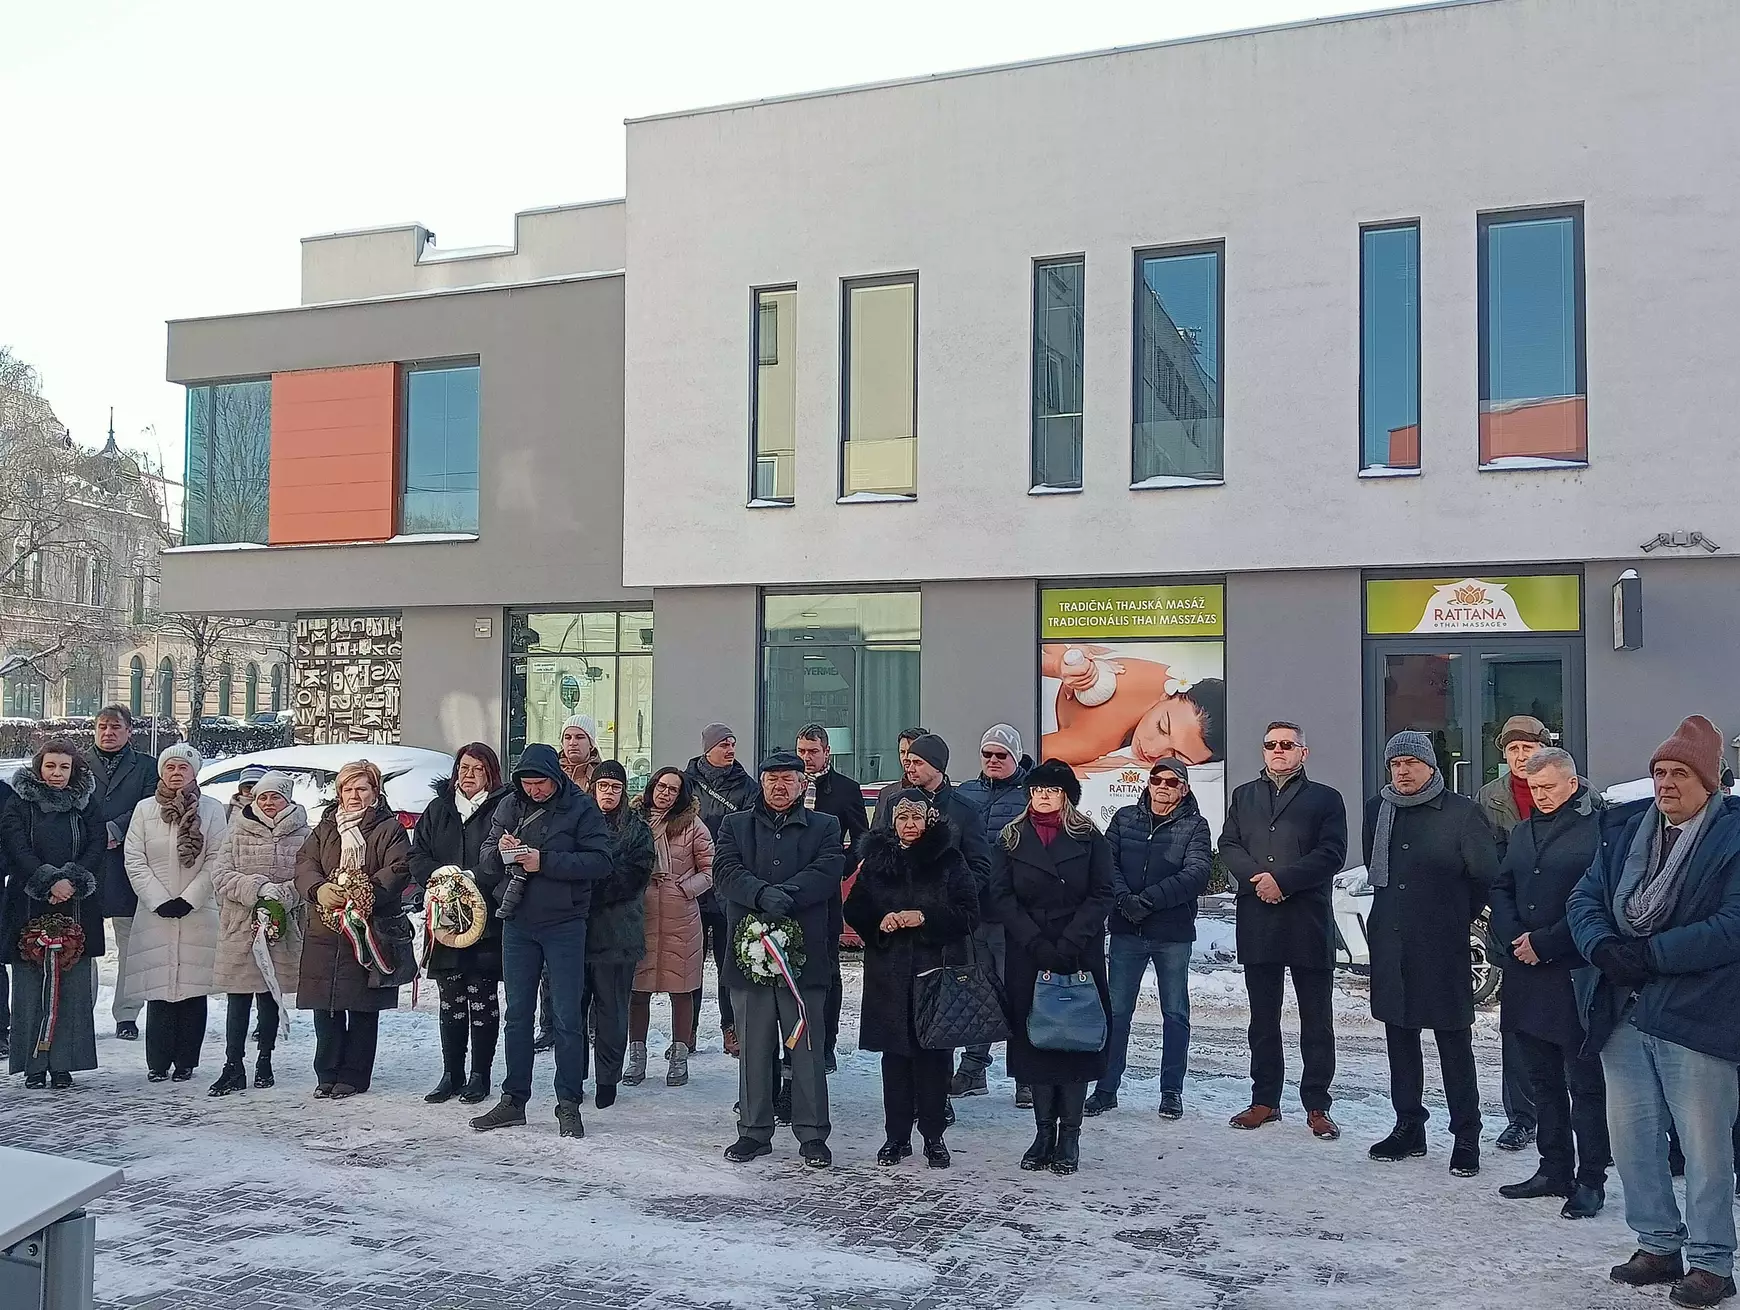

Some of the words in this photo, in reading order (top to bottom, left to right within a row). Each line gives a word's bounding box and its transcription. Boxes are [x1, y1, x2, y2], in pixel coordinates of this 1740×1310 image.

[1059, 599, 1113, 612] TRADIČNÁ
[1116, 598, 1162, 610] THAJSKÁ
[1166, 596, 1205, 609] MASÁŽ
[1048, 614, 1129, 627] TRADICIONÁLIS
[1132, 615, 1156, 626] THAI
[1159, 612, 1217, 625] MASSZÁZS
[1434, 608, 1506, 620] RATTANA
[1109, 785, 1145, 793] RATTAN
